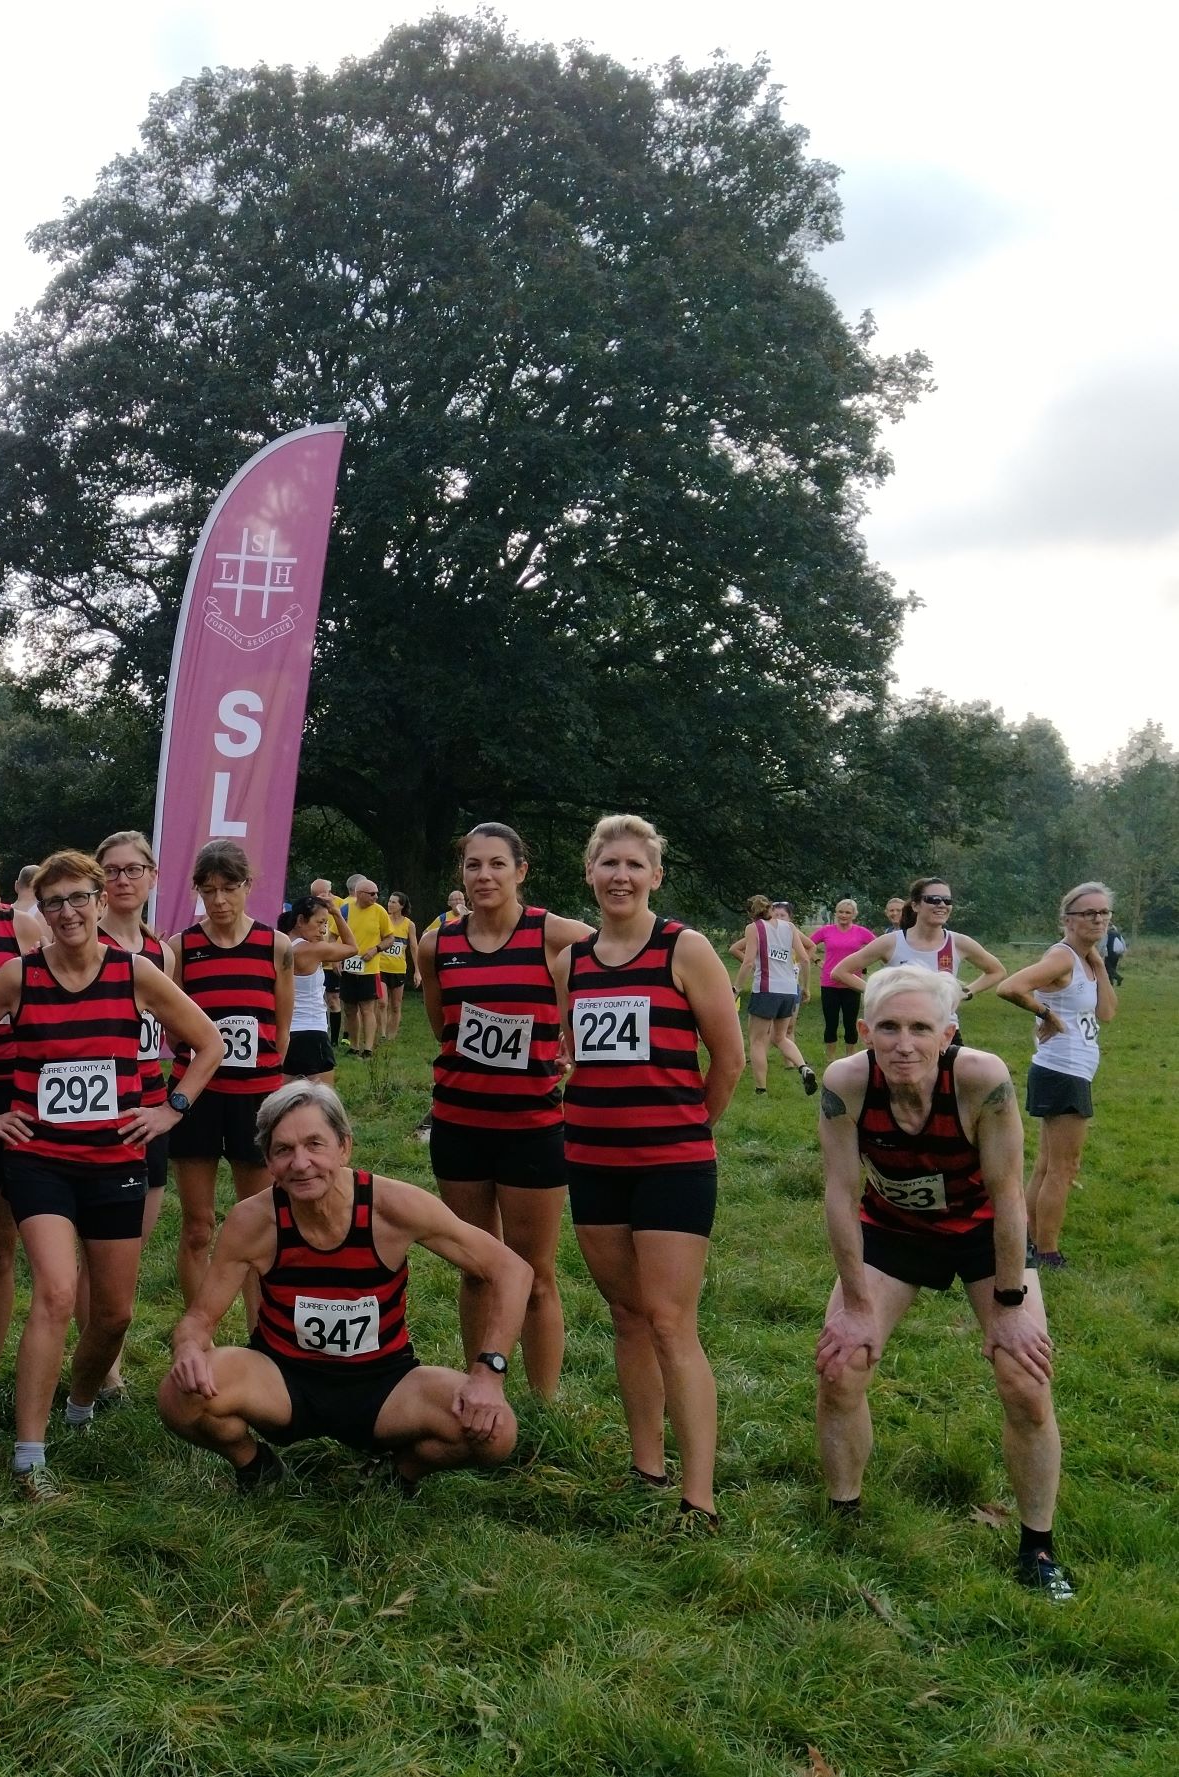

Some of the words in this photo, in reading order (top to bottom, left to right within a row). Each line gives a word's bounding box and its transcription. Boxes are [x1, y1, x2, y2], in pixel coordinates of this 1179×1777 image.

[251, 534, 265, 553] S
[219, 562, 234, 581] L
[273, 565, 293, 584] H
[208, 617, 243, 644] FORTUNA
[247, 621, 292, 647] SEQUATUR
[384, 944, 401, 955] 60
[770, 949, 789, 960] W55
[345, 960, 363, 971] 344
[577, 1002, 603, 1010] SURREY
[603, 1001, 632, 1009] COUNTY
[633, 1000, 645, 1008] AA
[464, 1006, 489, 1020] SURREY
[490, 1015, 519, 1025] COUNTY
[139, 1018, 159, 1053] 08
[462, 1018, 523, 1060] 204
[579, 1012, 641, 1052] 224
[220, 1027, 252, 1061] 63
[40, 1066, 68, 1075] SURREY
[69, 1064, 99, 1073] COUNTY
[45, 1074, 110, 1115] 292
[299, 1301, 329, 1311] SURREY
[363, 1300, 375, 1308] AA
[304, 1315, 372, 1352] 347
